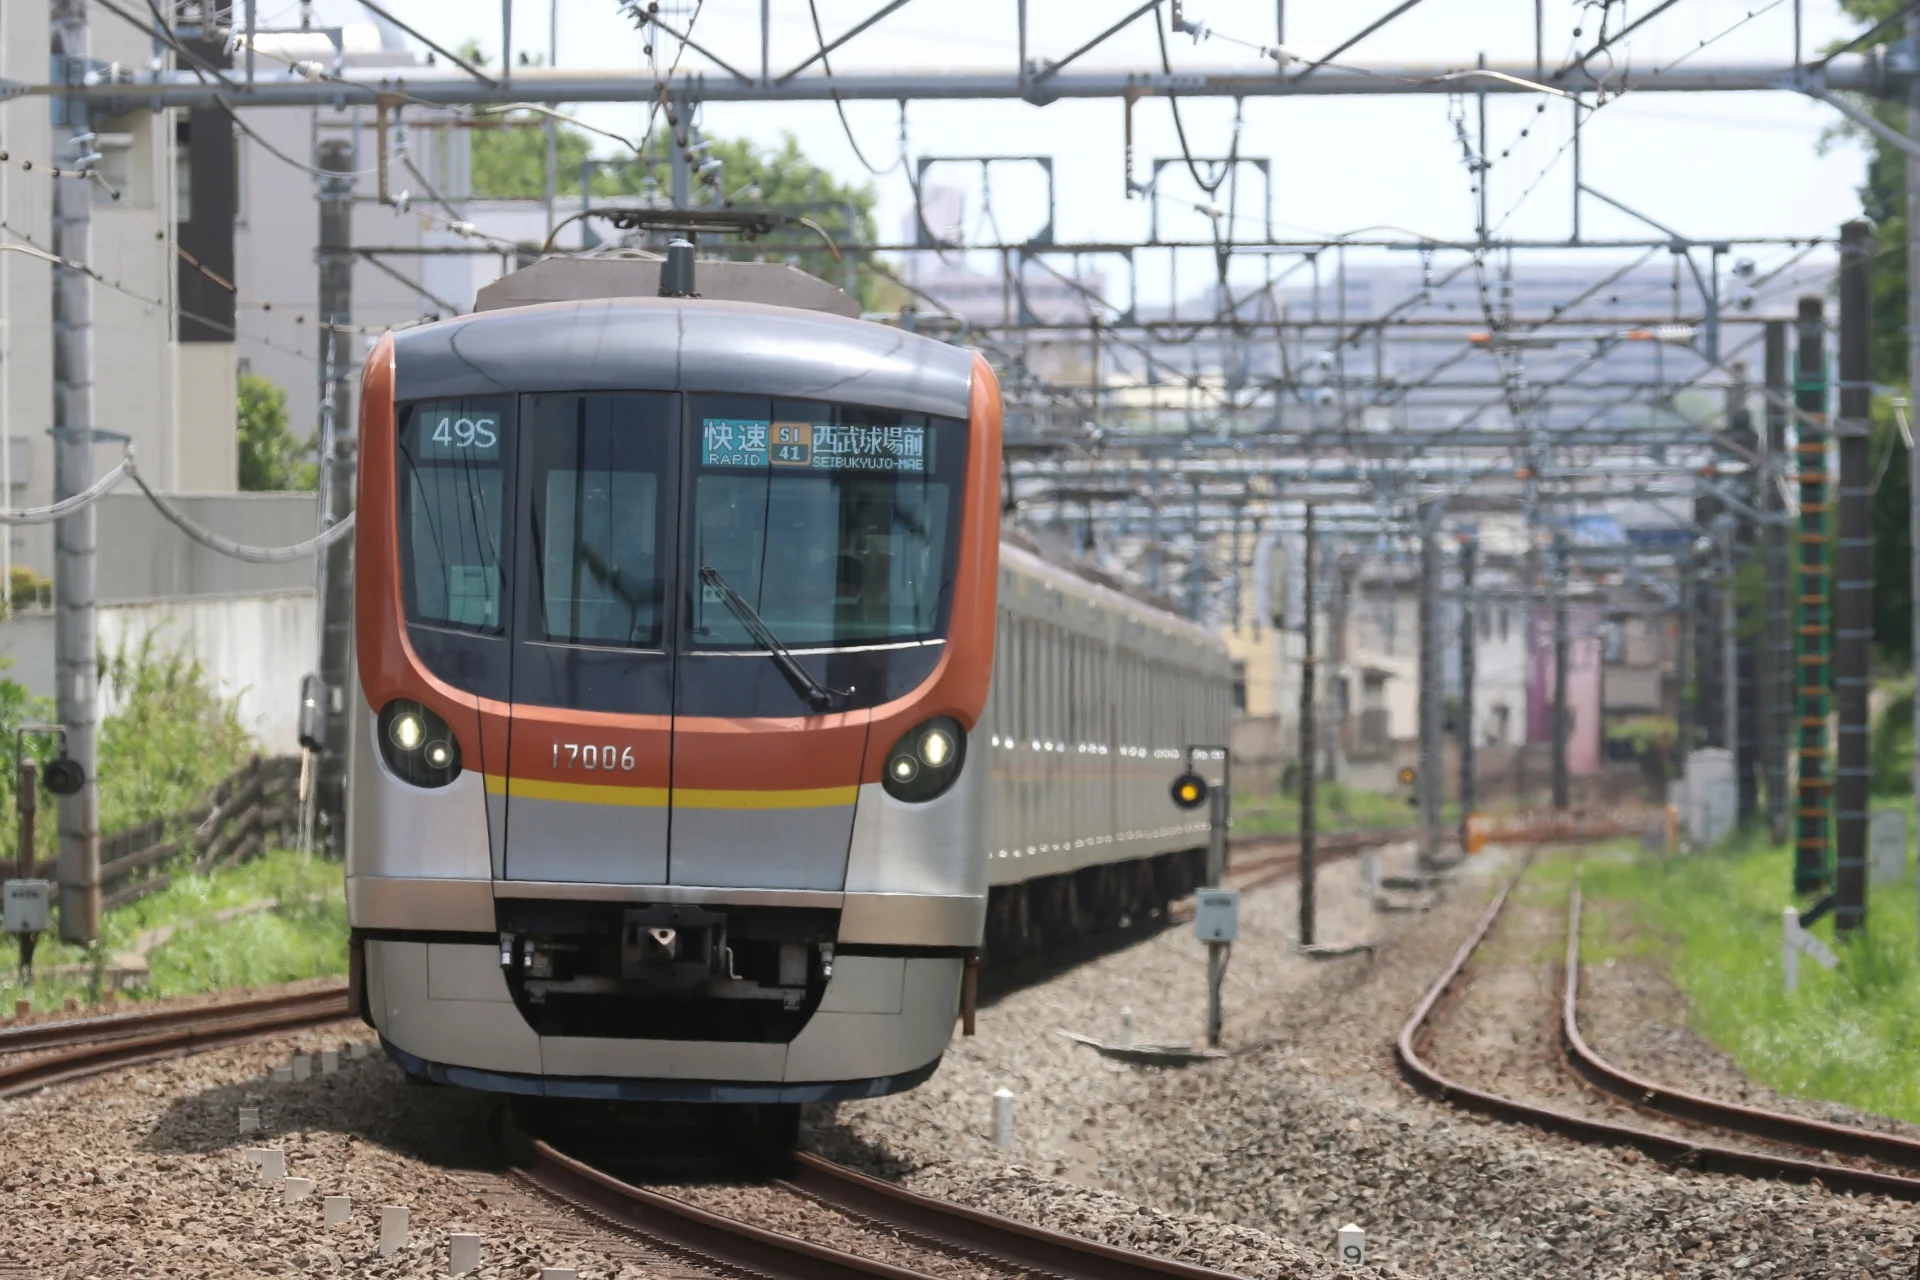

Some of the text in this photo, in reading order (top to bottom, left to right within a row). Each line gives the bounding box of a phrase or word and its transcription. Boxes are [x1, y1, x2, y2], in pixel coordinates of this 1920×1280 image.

[431, 417, 497, 448] 49S
[704, 421, 767, 452] 快速
[780, 428, 799, 443] SI
[813, 425, 924, 456] 西武球場前
[709, 453, 760, 465] RAPID
[779, 446, 800, 461] 41
[812, 456, 924, 471] SEIBUKYUJO-MAE
[552, 743, 635, 771] 17006
[1343, 1245, 1361, 1264] 9
